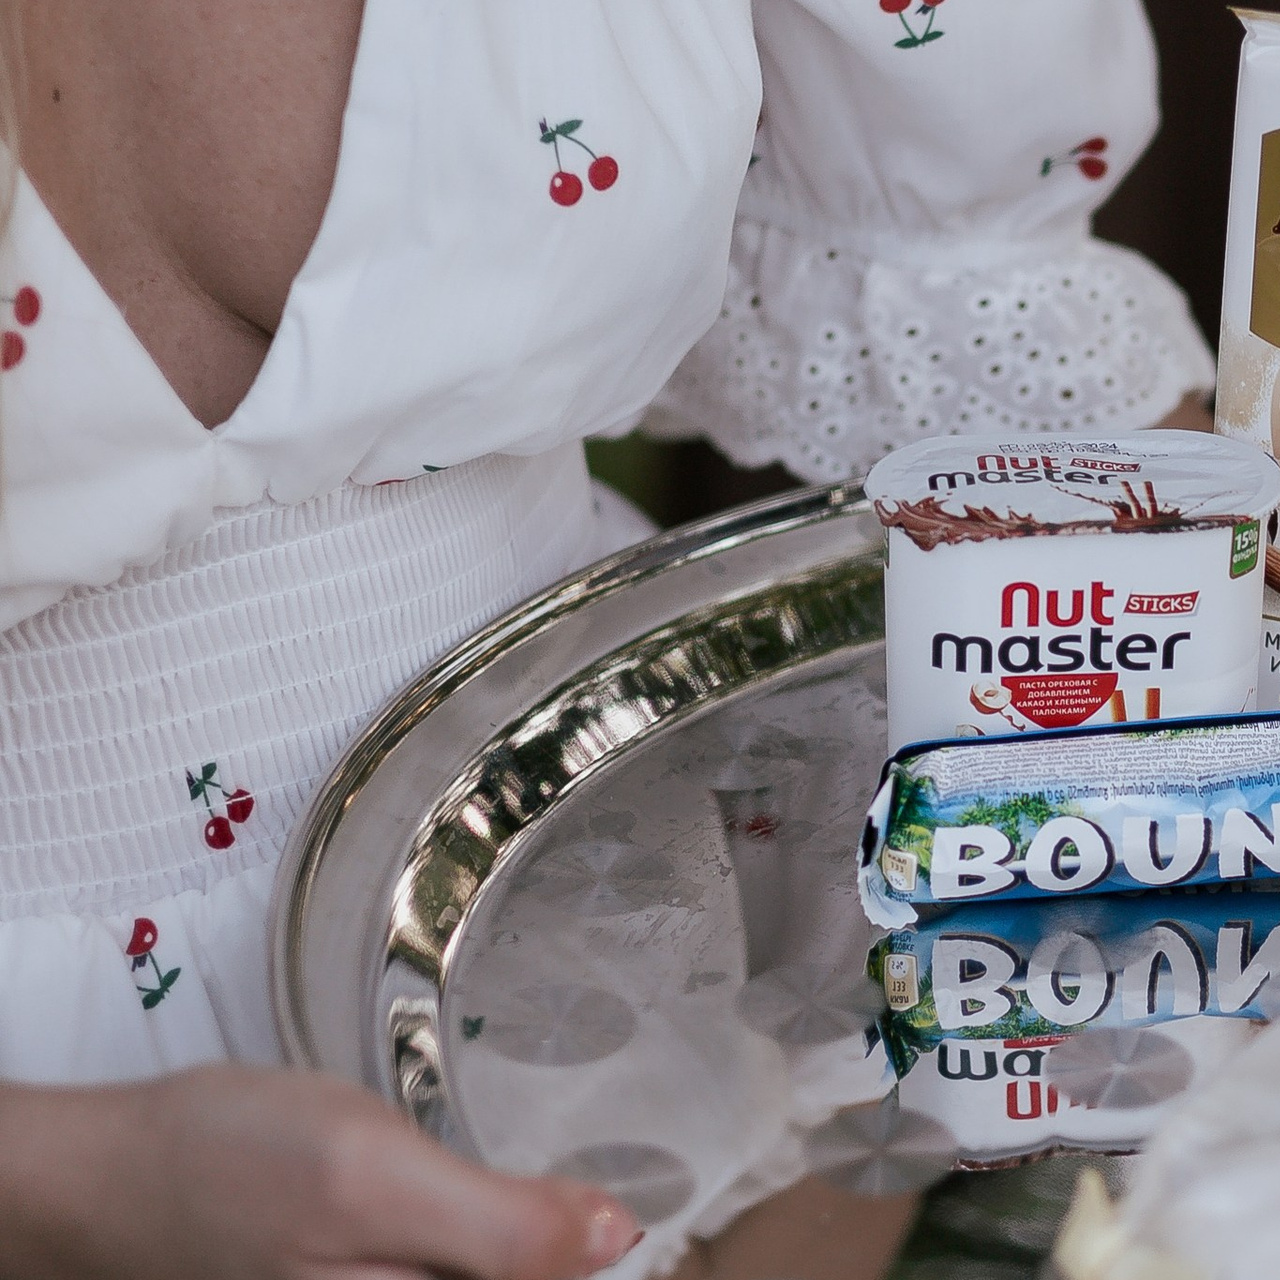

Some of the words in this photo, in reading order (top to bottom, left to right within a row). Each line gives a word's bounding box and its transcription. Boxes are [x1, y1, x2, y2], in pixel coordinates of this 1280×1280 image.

[976, 454, 1061, 472] nut
[1074, 459, 1135, 471] STICKS
[928, 468, 1119, 491] master
[1000, 581, 1114, 628] nut
[1128, 594, 1194, 614] STICKS
[931, 627, 1192, 674] master
[1019, 681, 1047, 689] ПАСТА
[1048, 679, 1091, 688] ОРЕХОВАЯ
[1027, 689, 1091, 699] ДОБАВЛЕНИЕМ
[1016, 699, 1045, 708] КАКАО
[1054, 696, 1102, 706] ХЛЕБНЫМИ
[1032, 707, 1086, 716] ПАЛОЧКАМИ
